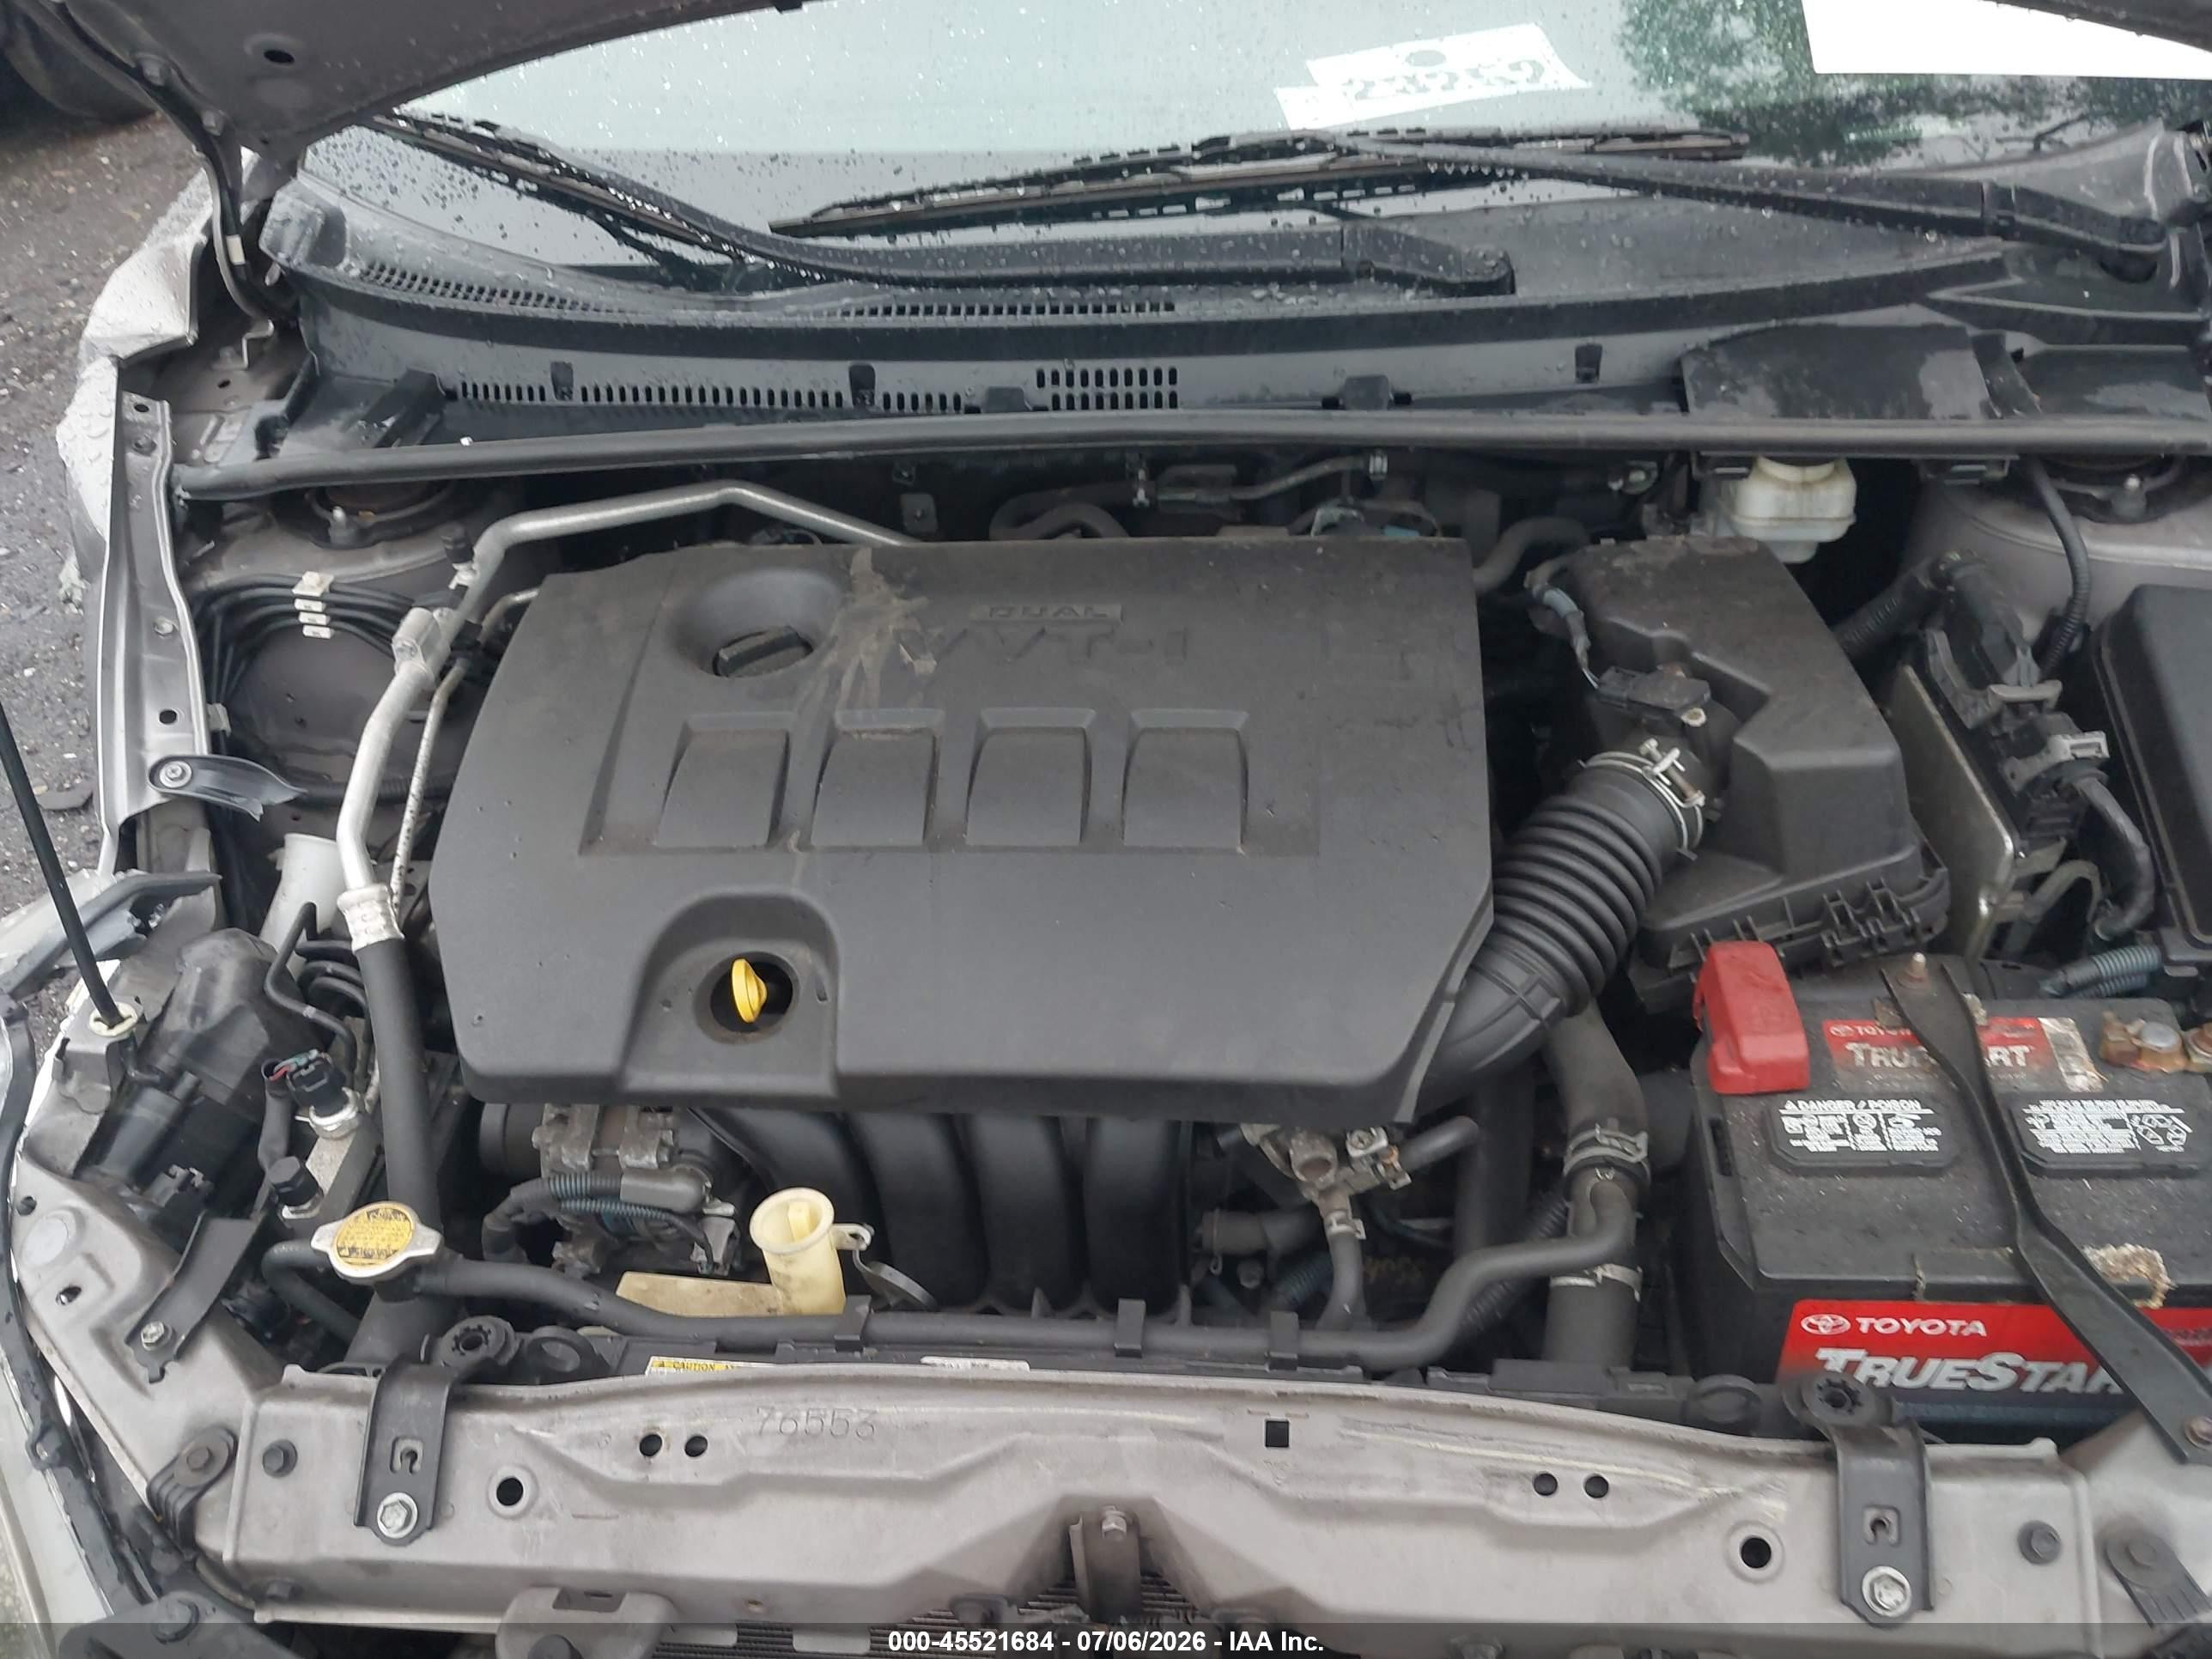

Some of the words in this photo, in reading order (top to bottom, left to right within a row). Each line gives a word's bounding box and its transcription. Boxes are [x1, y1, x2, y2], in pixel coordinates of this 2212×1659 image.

[988, 605, 1109, 619] DUAL
[1797, 1099, 1856, 1110] DANGER
[1868, 1099, 1921, 1110] POISON
[1855, 1316, 1988, 1337] TOYOTA
[672, 1361, 715, 1371] CAUTION
[1814, 1346, 2125, 1395] TRUESTAR
[756, 1406, 878, 1441] 76553
